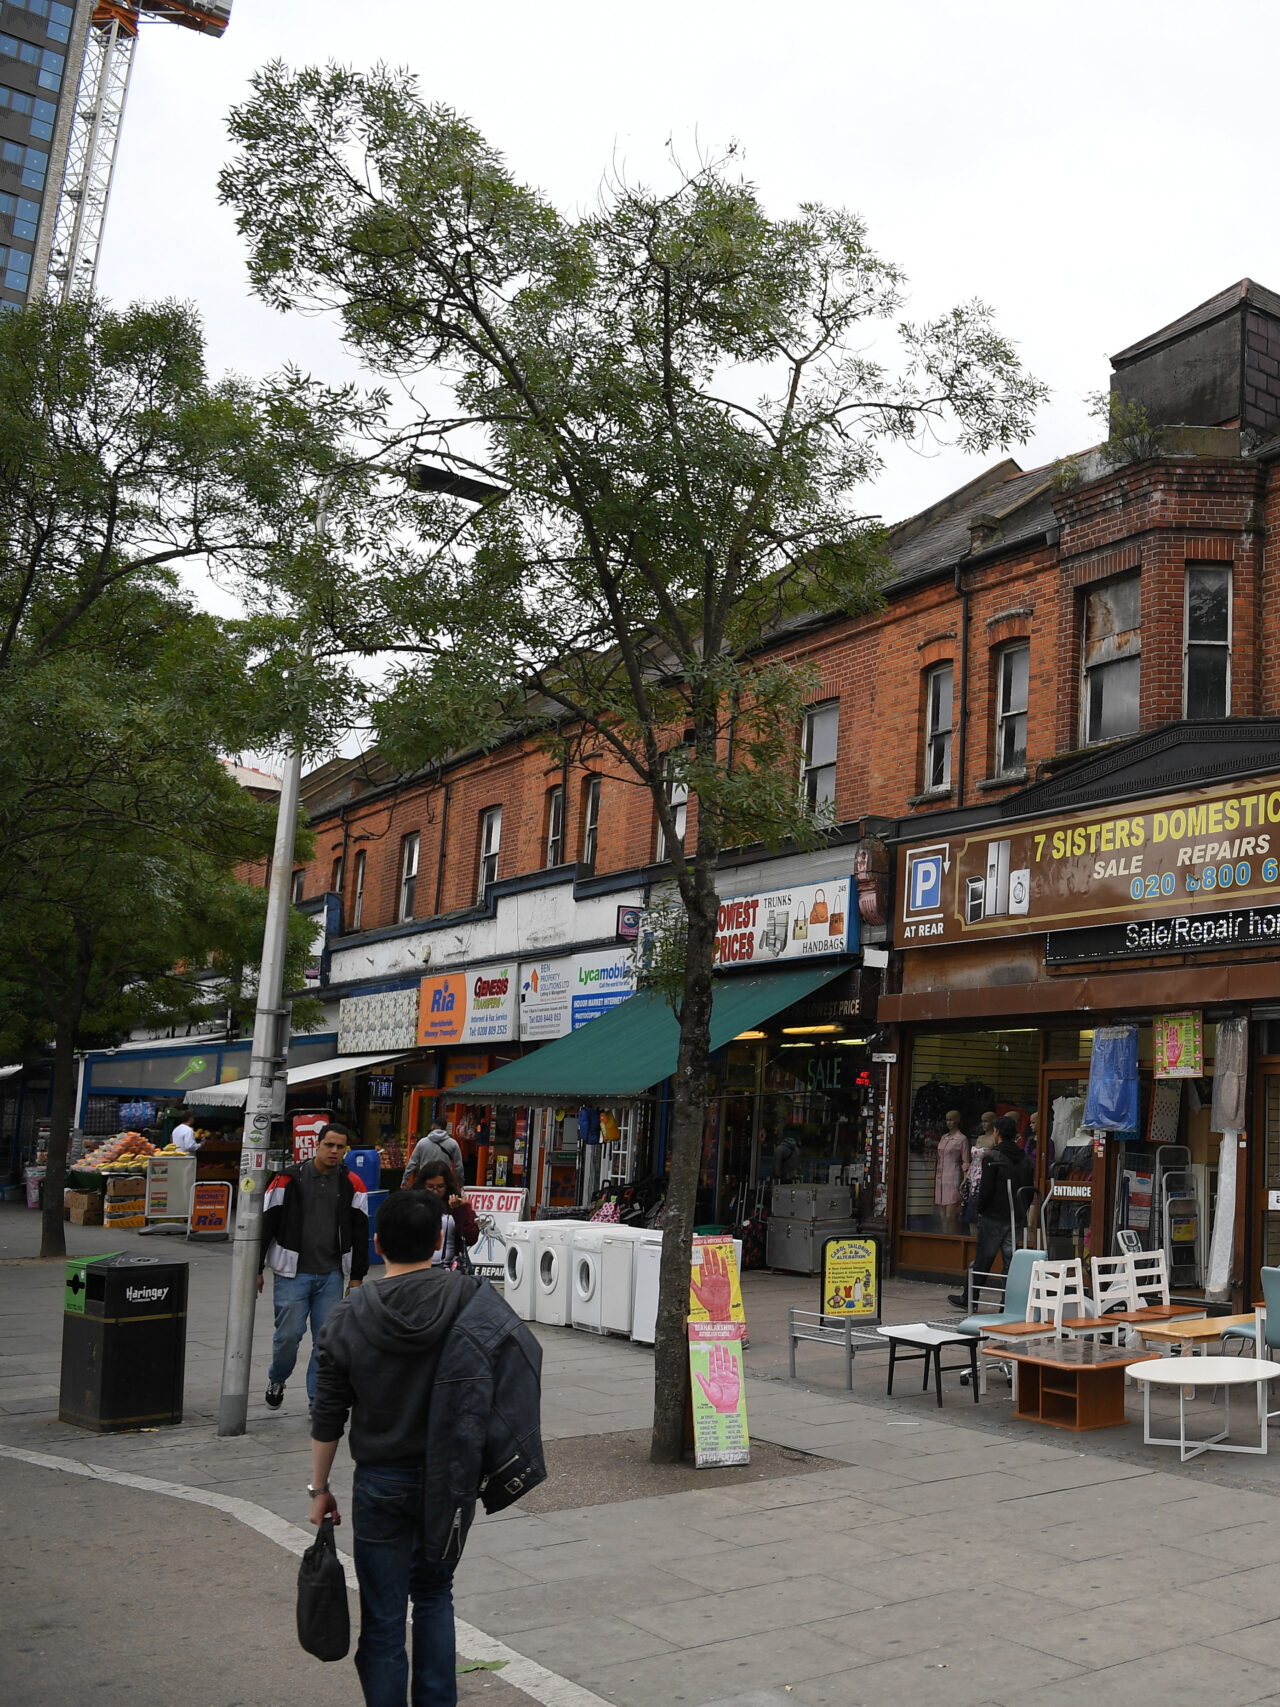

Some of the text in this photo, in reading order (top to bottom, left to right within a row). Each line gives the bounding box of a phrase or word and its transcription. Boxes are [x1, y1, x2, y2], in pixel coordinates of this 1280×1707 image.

[1034, 834, 1046, 862] 7
[1052, 816, 1145, 860] SISTERS
[1093, 855, 1144, 879] SALE
[1177, 834, 1271, 867] REPAIRS
[1130, 872, 1176, 900] 020
[1185, 861, 1251, 892] 8800
[764, 894, 792, 909] TRUNKS
[838, 884, 847, 893] 245
[904, 924, 944, 938] AT REAR
[1126, 912, 1243, 948] Sale/Repair
[713, 931, 755, 963] PRICES
[802, 937, 844, 953] HANDBAGS
[540, 963, 550, 973] BEN
[540, 972, 560, 982] PROPERTY
[474, 976, 509, 998] GENESIS
[431, 979, 455, 1013] Ria
[838, 999, 860, 1016] PRICE
[807, 1057, 842, 1091] SALE
[295, 1136, 320, 1149] KEY
[300, 1149, 318, 1160] CU
[1053, 1185, 1092, 1198] ENTRANCE
[465, 1194, 521, 1211] KEYS CUT
[196, 1212, 224, 1227] Ria
[847, 1243, 873, 1257] TAILORING
[126, 1286, 170, 1301] Haringey
